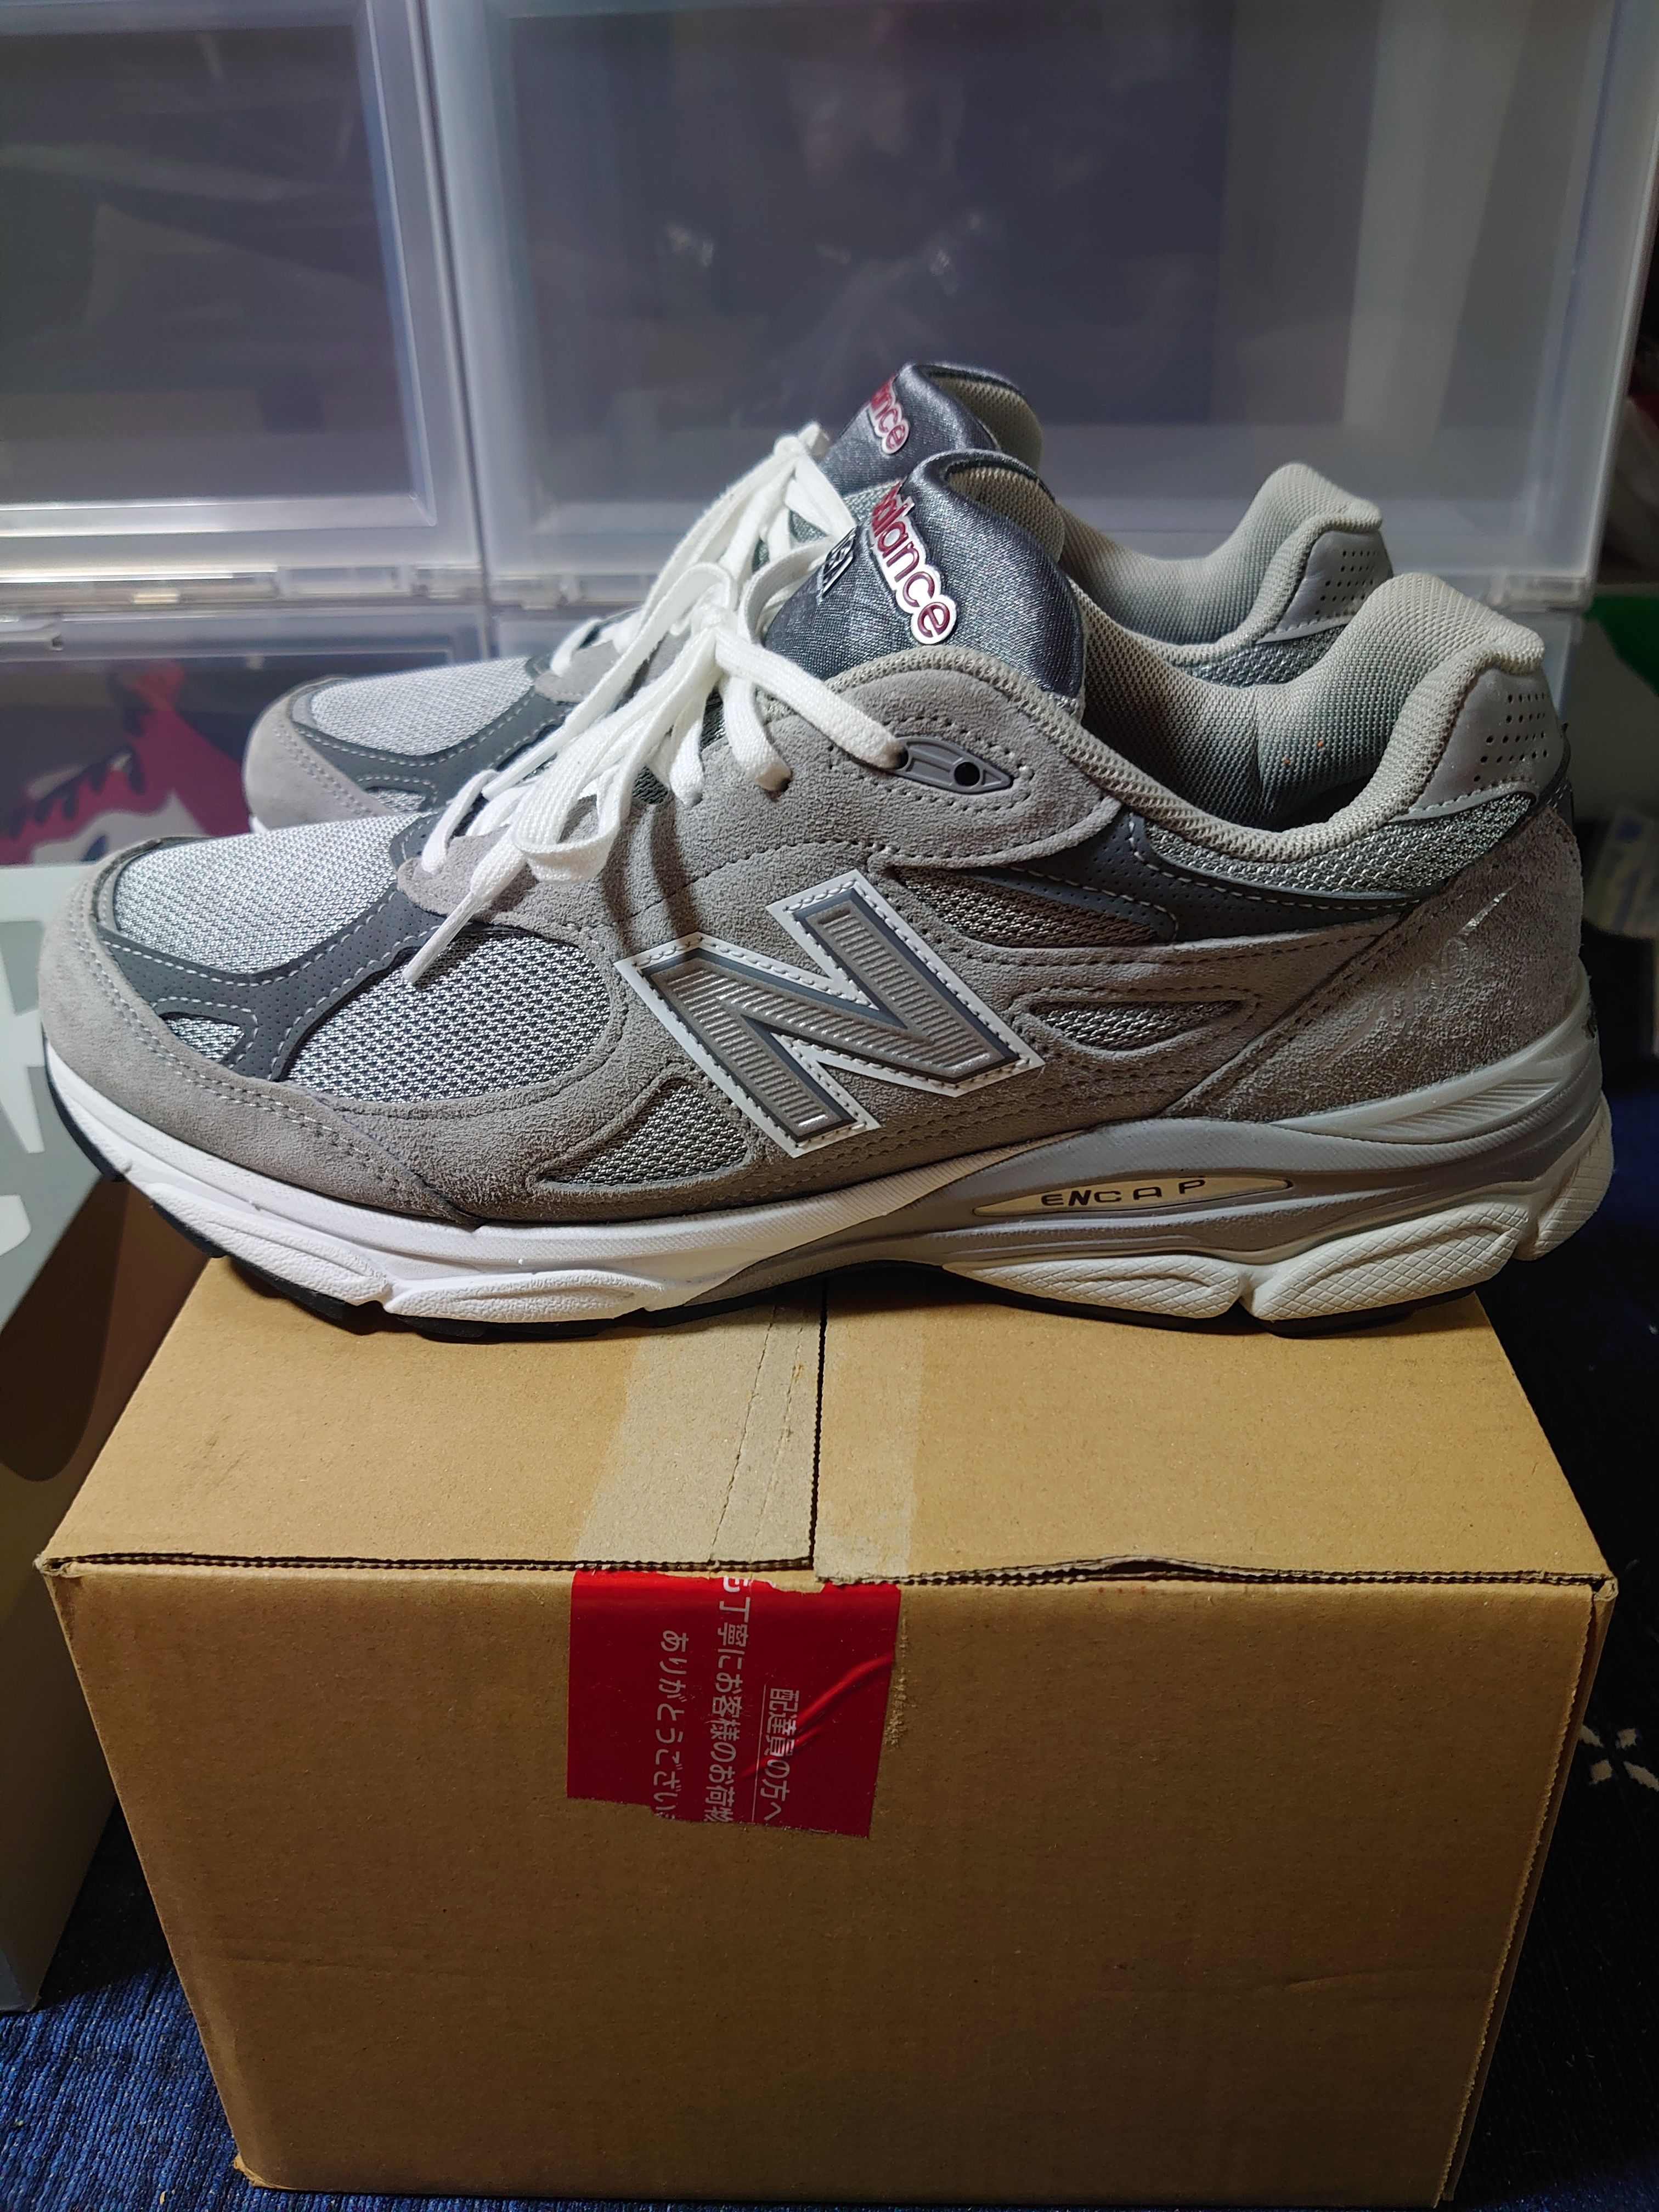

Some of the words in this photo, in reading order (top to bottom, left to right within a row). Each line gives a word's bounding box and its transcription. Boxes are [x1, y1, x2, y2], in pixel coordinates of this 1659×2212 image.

[1041, 1179, 1206, 1207] ENCAP
[651, 1629, 689, 1819] ありがとうござい
[761, 1688, 800, 1821] 配達員の方へ
